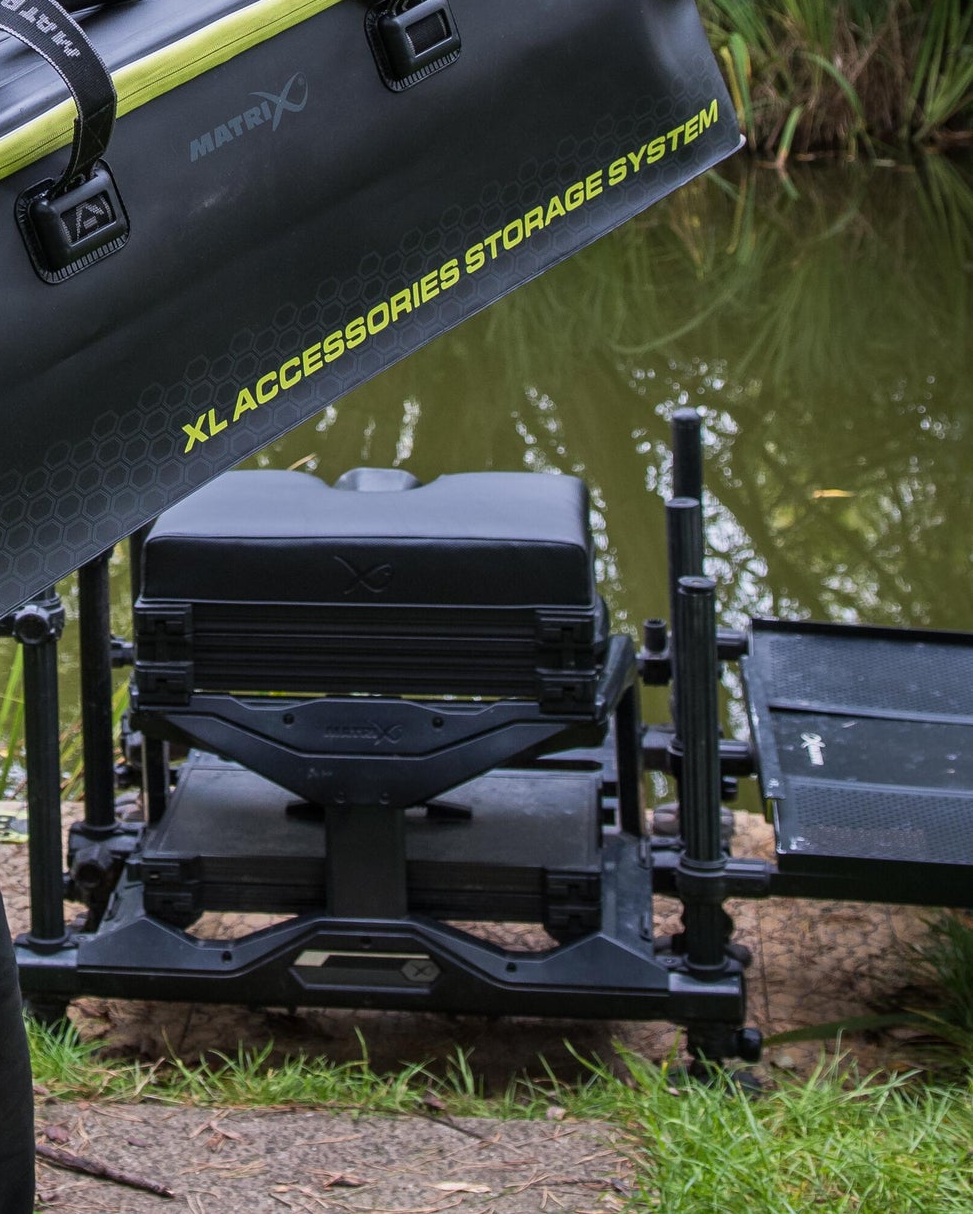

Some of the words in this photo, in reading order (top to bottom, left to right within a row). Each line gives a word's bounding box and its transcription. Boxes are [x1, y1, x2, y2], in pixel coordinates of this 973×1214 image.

[190, 72, 308, 163] MATRIX
[182, 404, 228, 453] XL
[232, 259, 460, 422] ACCESSORIES
[466, 170, 603, 274] STORAGE
[608, 99, 719, 187] SYSTEM
